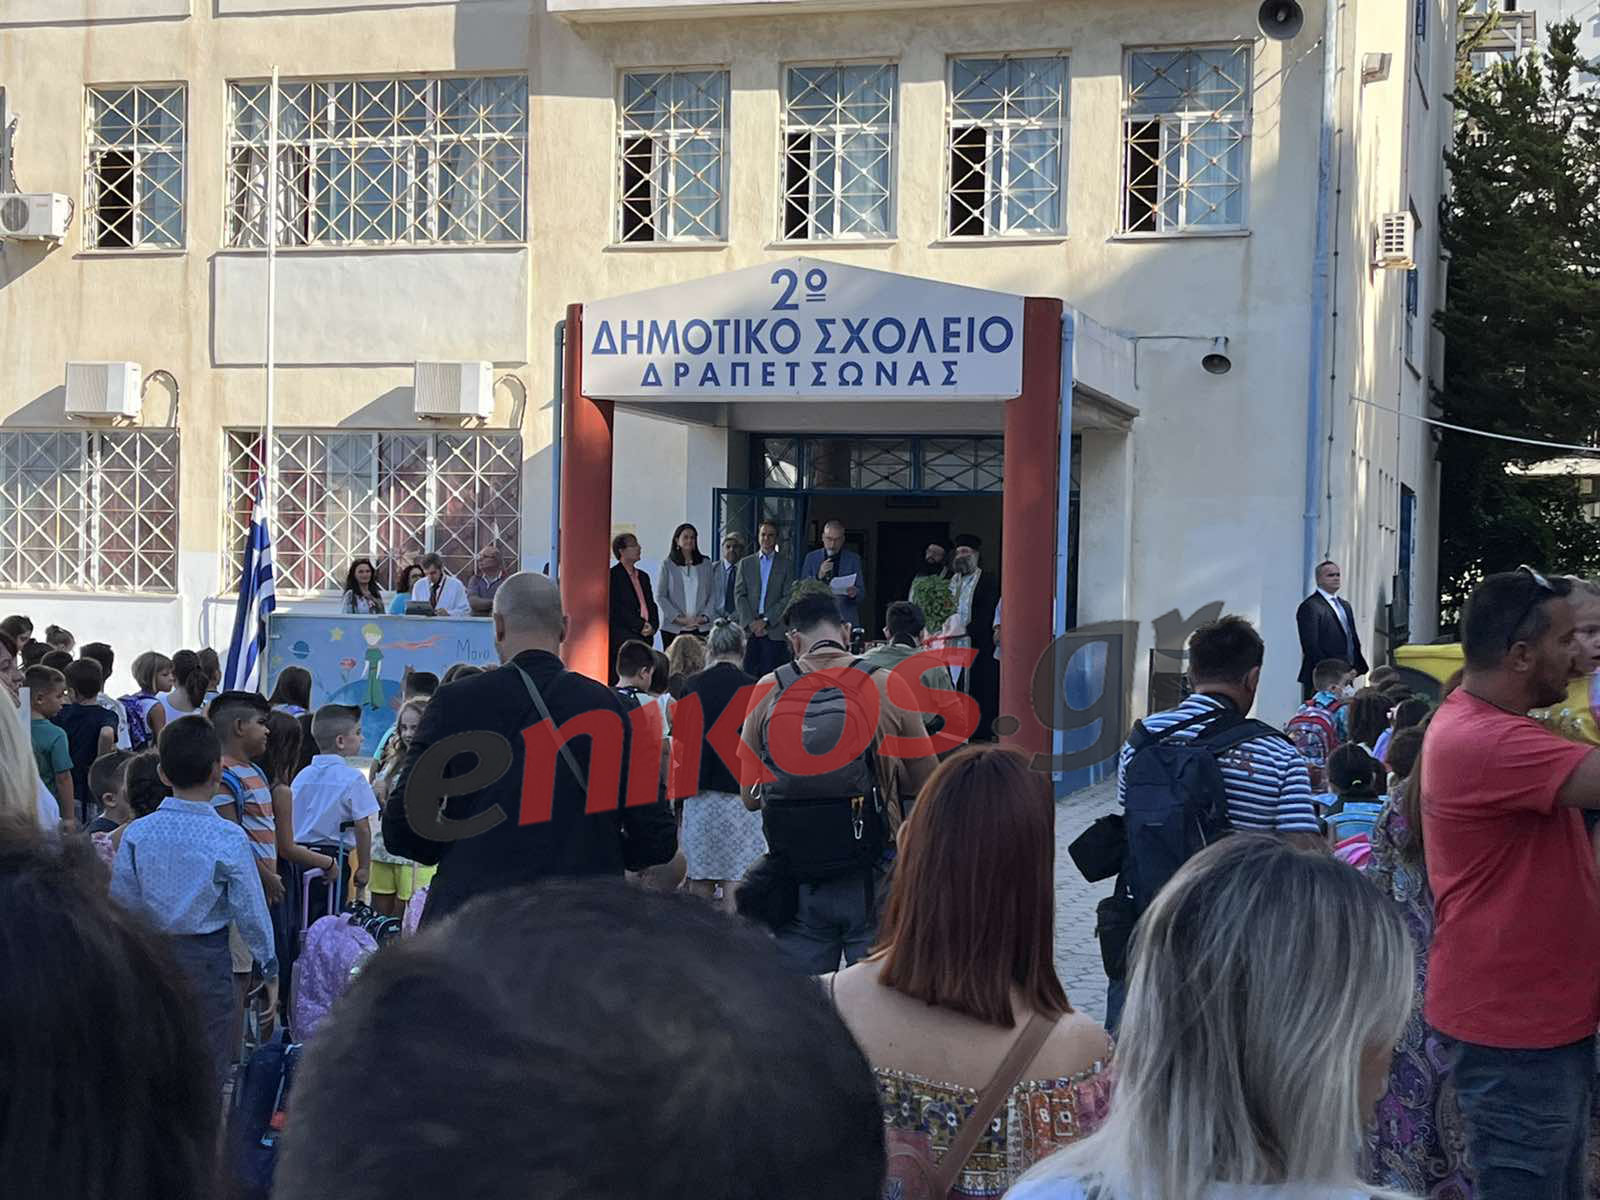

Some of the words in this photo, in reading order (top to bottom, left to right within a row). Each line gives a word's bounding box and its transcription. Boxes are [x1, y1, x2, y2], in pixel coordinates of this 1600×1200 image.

[591, 317, 801, 355] ΔΗΜΟΤΙΚΟ
[814, 315, 1014, 354] ΣΧΟΛΕΙΟ
[641, 359, 959, 388] ΔΡΑΠΕΤΣΩΝΑΣ
